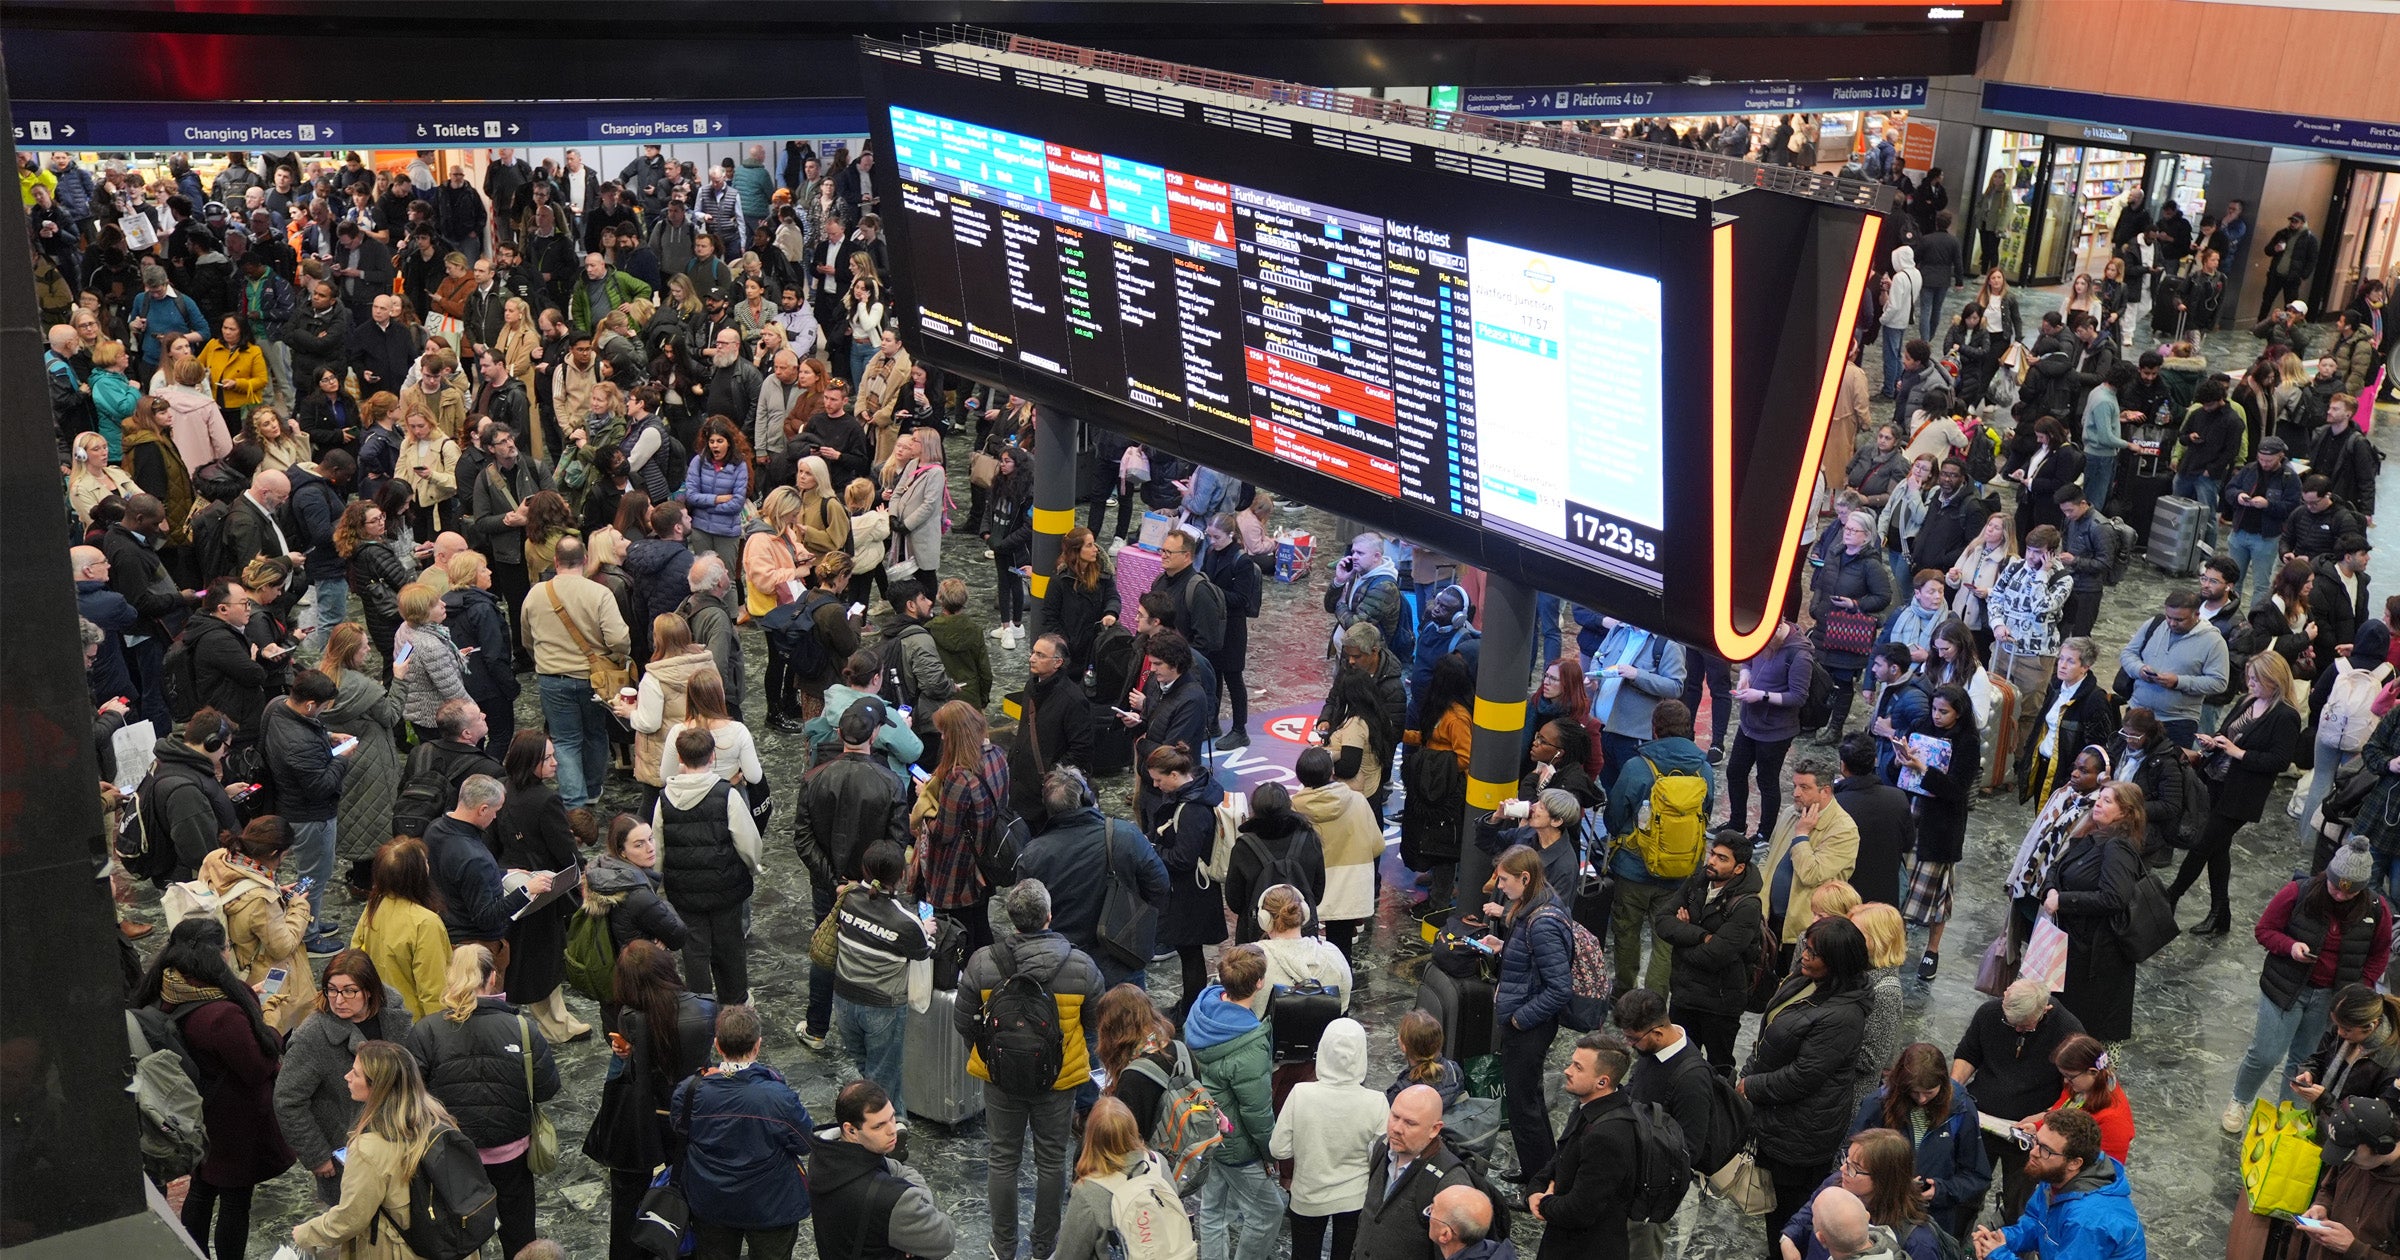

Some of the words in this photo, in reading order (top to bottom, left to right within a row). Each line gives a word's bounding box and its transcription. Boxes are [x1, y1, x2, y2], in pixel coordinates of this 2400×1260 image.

[1573, 92, 1622, 106] Platforms
[1624, 92, 1631, 105] 4
[1633, 94, 1644, 105] to
[1646, 92, 1654, 105] 7
[1833, 86, 1873, 100] Platforms
[1874, 86, 1880, 98] 1
[1882, 87, 1890, 98] to
[1892, 86, 1898, 98] 3
[1745, 99, 1769, 109] Changing
[1770, 99, 1786, 107] Places
[184, 127, 248, 142] Changing
[251, 127, 292, 139] Places
[433, 123, 480, 137] Toilets
[601, 122, 653, 137] Changing
[655, 121, 688, 133] Places
[2092, 127, 2128, 142] WHSmith
[2370, 126, 2386, 136] First
[2351, 138, 2392, 150] Restaurants
[1235, 187, 1264, 206] Further
[1265, 194, 1312, 217] departures
[1387, 220, 1412, 240] Next
[1413, 225, 1451, 248] fastest
[1388, 239, 1412, 258] train
[1414, 246, 1426, 261] to
[1388, 260, 1420, 276] Destination
[1452, 256, 1460, 267] of
[1460, 259, 1465, 268] 4
[1390, 275, 1416, 288] Lancaster
[1439, 272, 1451, 284] Plat
[1452, 276, 1469, 288] Time
[1390, 288, 1413, 302] Leighton
[1414, 294, 1436, 308] Buzzard
[1392, 316, 1416, 330] Liverpool
[1416, 322, 1420, 331] L
[1418, 310, 1435, 322] Valley
[1393, 330, 1418, 344] Lockerbie
[1394, 343, 1426, 360] Macclesfield
[1394, 356, 1426, 372] Manchester
[1396, 370, 1413, 382] Milton
[1412, 374, 1432, 388] Keynes
[1396, 383, 1414, 395] Milton
[1414, 388, 1432, 400] Keynes
[1397, 396, 1426, 412] Motherwell
[1398, 409, 1414, 422] North
[1413, 414, 1438, 430] Wembley
[1398, 422, 1434, 441] Northampton
[1399, 435, 1426, 450] Nuneaton
[2132, 439, 2161, 449] SPORTS
[1400, 448, 1430, 466] Oxenholme
[1401, 460, 1420, 474] Penrith
[1402, 474, 1422, 488] Preston
[1402, 486, 1423, 500] Queens
[1423, 493, 1436, 505] Park
[1572, 512, 1634, 554] 17:23
[1634, 538, 1656, 562] 53
[852, 914, 899, 942] FRANS
